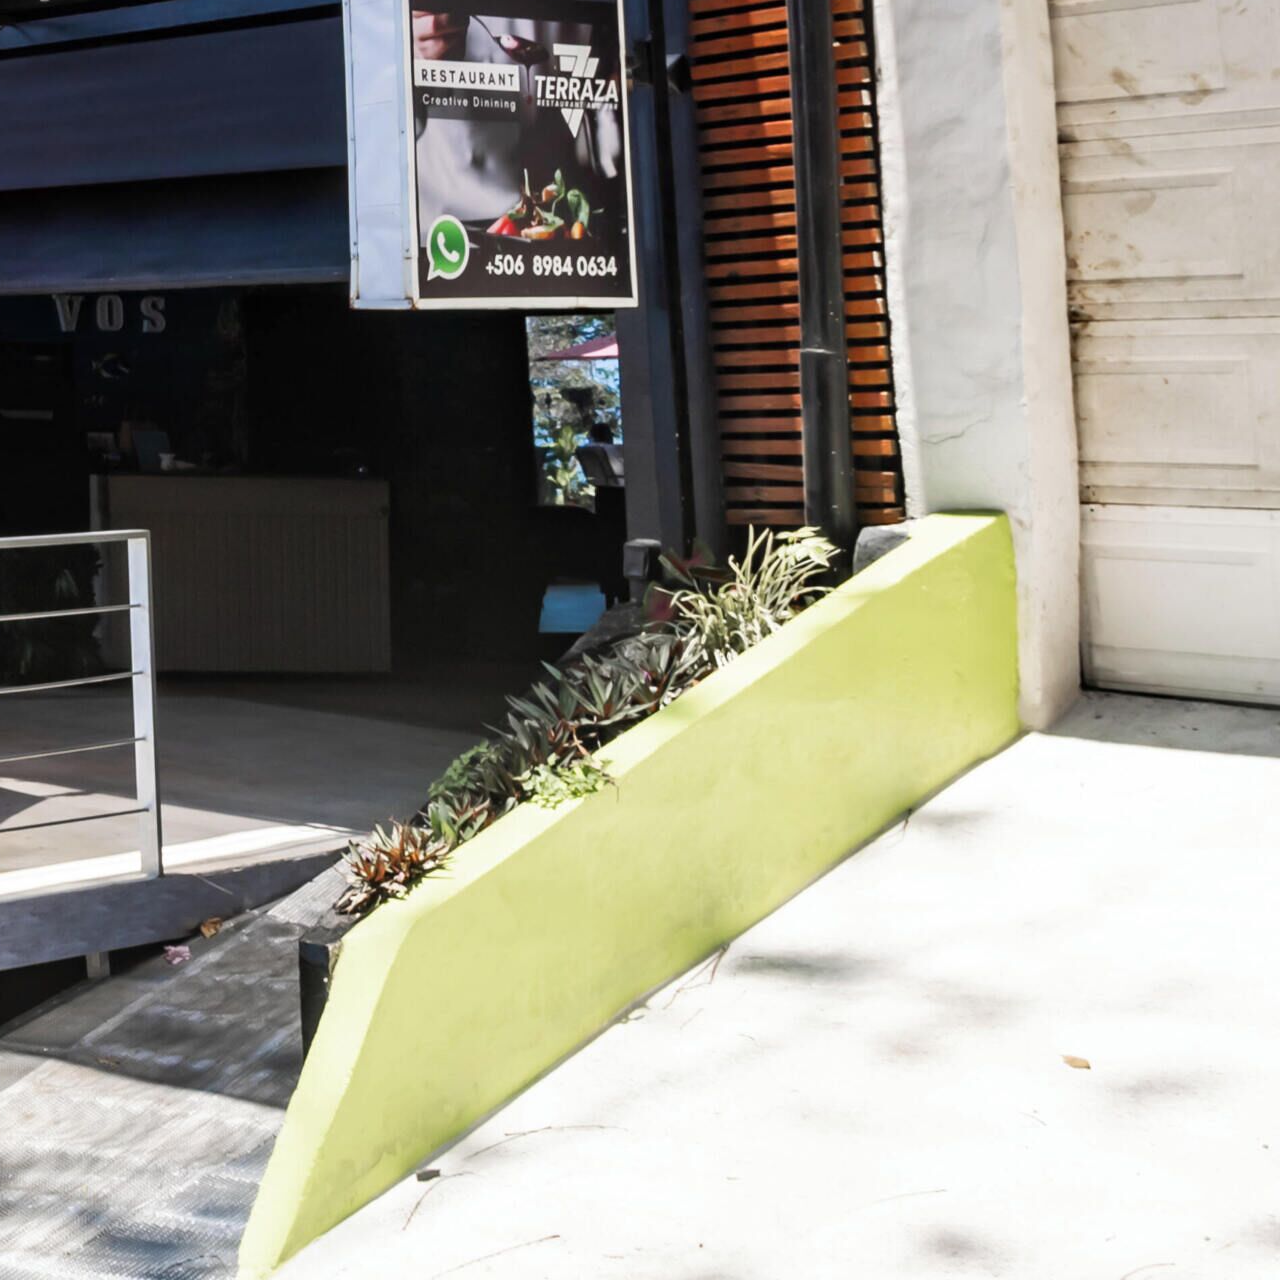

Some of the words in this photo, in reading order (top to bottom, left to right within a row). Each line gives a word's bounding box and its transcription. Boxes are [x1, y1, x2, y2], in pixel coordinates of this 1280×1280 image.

[421, 68, 515, 87] RESTAURANT
[534, 75, 619, 103] TERRAZA
[422, 93, 469, 108] Creative
[473, 95, 516, 113] Dinining
[536, 99, 583, 109] RESTAURANT
[485, 254, 525, 276] +506
[532, 254, 574, 277] 8984
[576, 255, 618, 277] 0634
[51, 293, 167, 333] VOS
